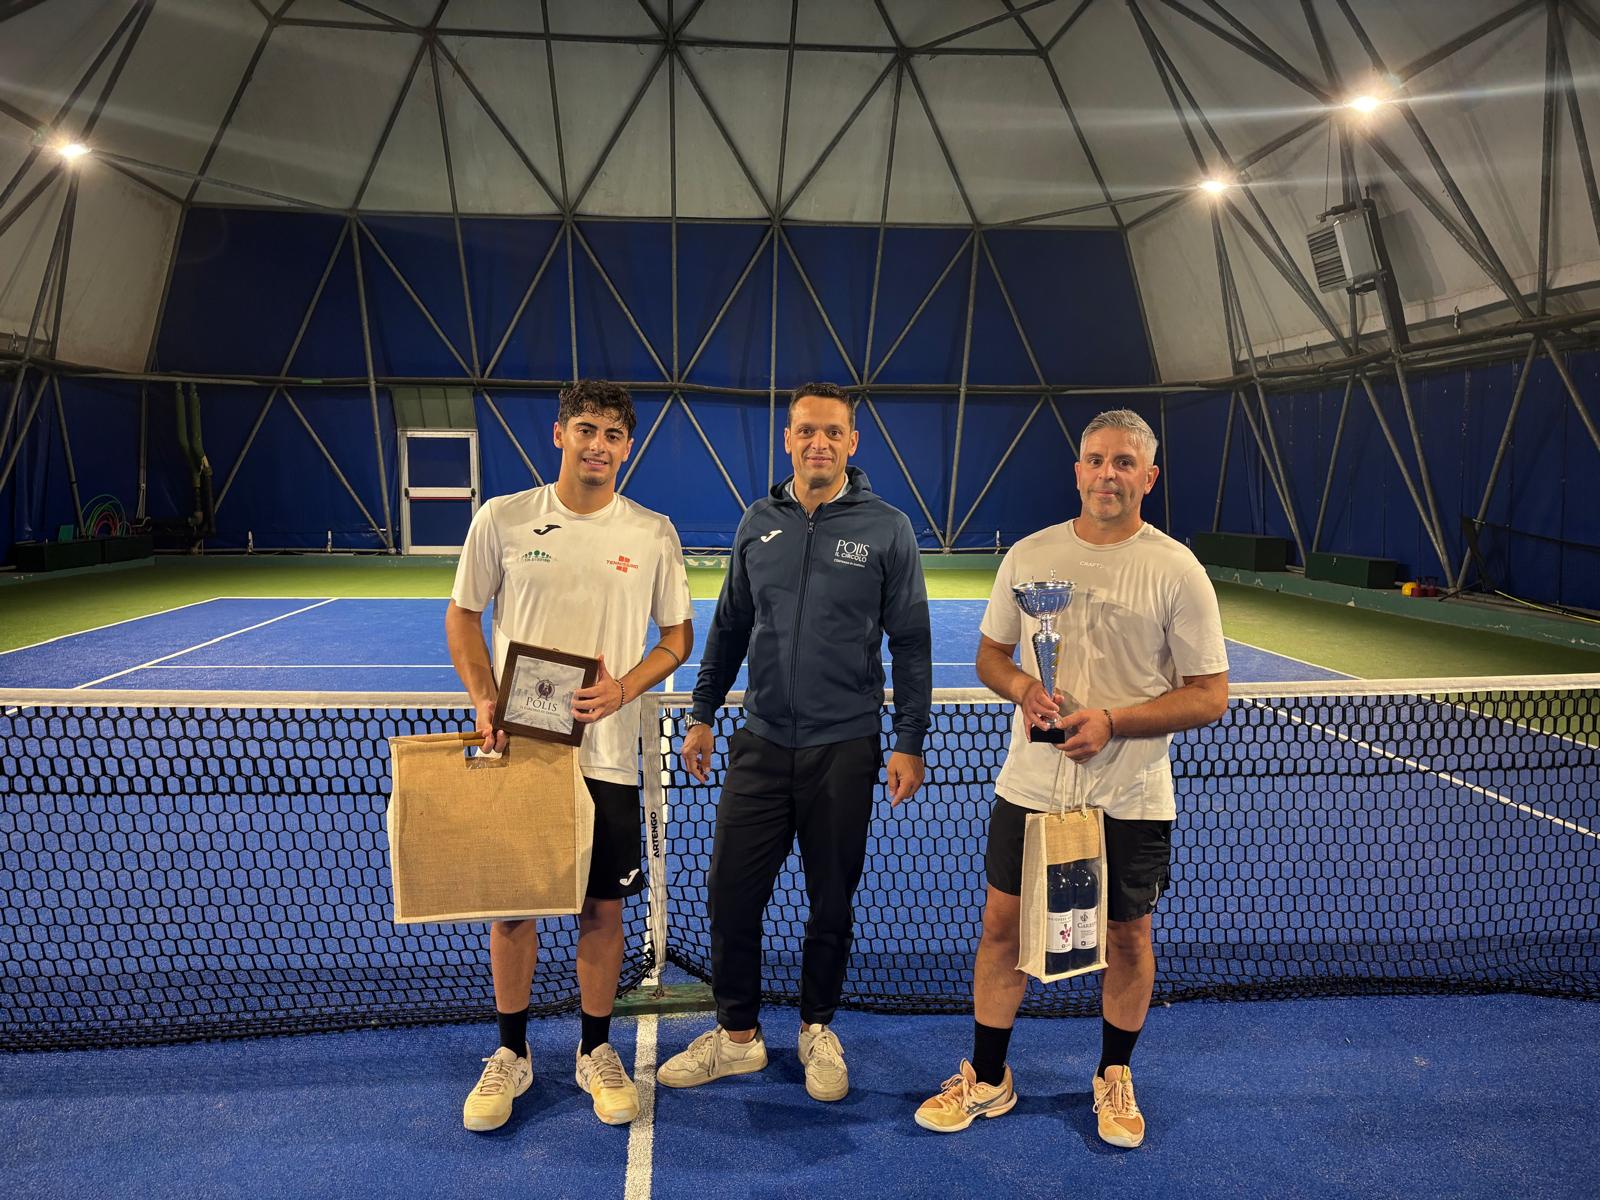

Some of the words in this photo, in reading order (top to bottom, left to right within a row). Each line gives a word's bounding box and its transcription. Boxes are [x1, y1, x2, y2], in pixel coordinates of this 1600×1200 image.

[836, 539, 870, 557] POLIS
[841, 552, 867, 563] CIRCOLO
[526, 696, 558, 712] POLIS
[650, 811, 659, 858] ARTENGO
